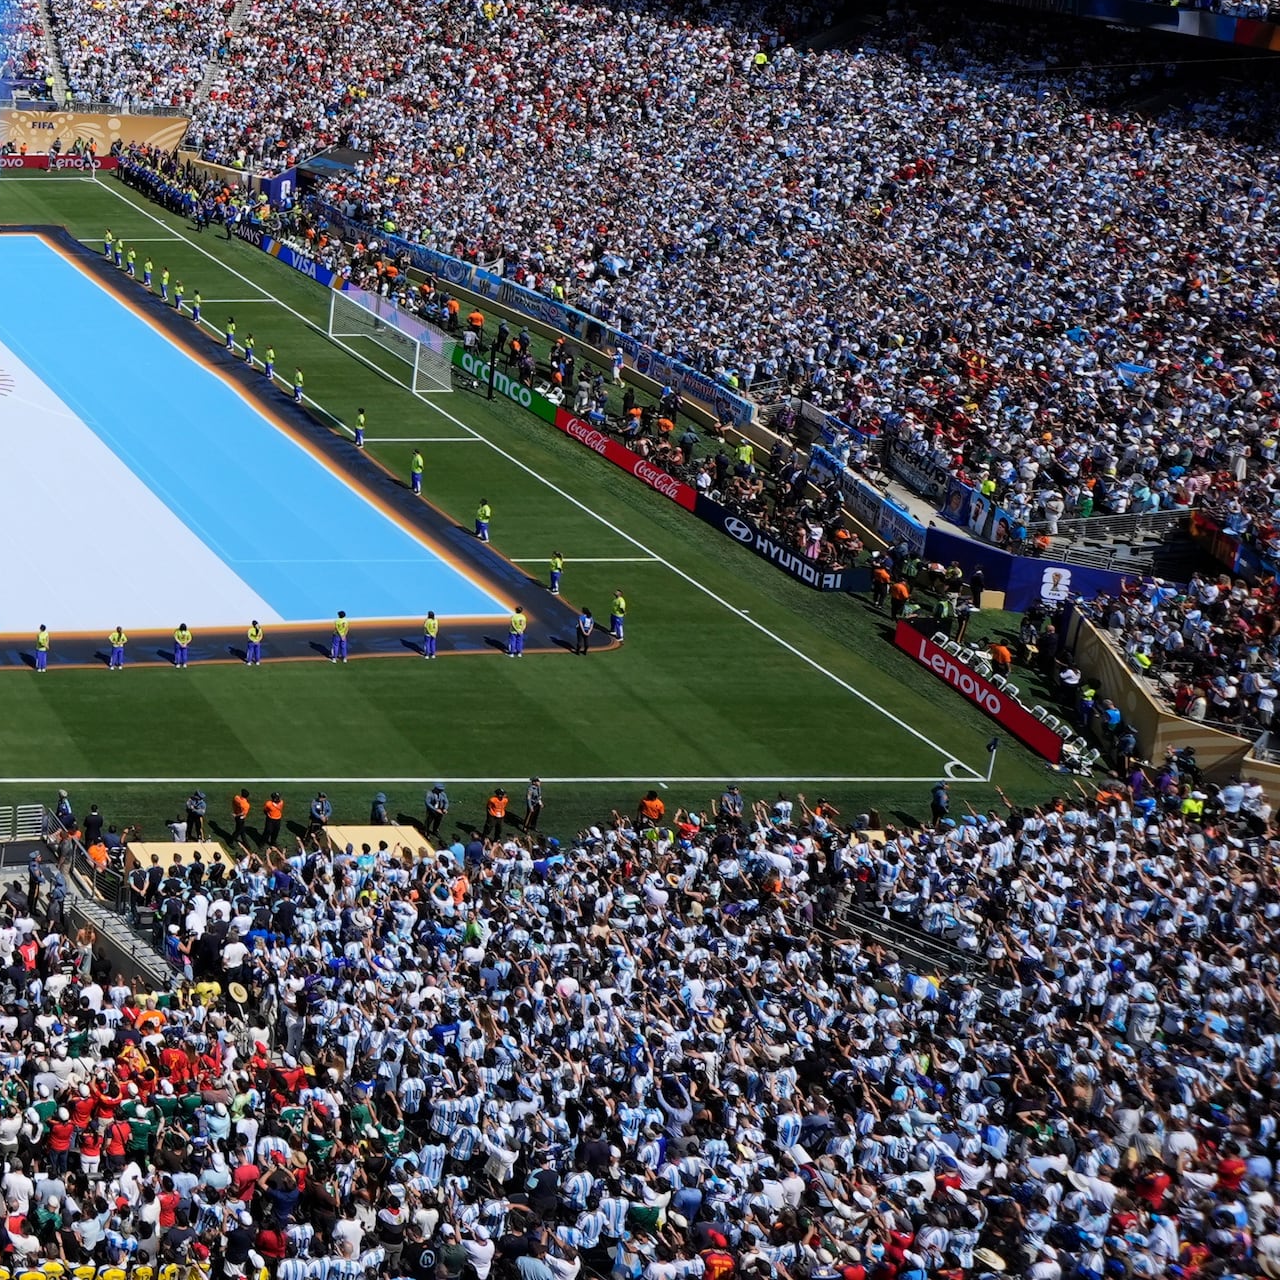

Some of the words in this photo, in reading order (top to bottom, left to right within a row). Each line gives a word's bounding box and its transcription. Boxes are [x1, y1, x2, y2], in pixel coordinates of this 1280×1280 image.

[32, 122, 55, 131] FIFA
[51, 157, 101, 169] Lenoo
[291, 252, 318, 280] VISA
[756, 534, 842, 588] HYUNDAI
[918, 637, 1002, 715] Lenovo
